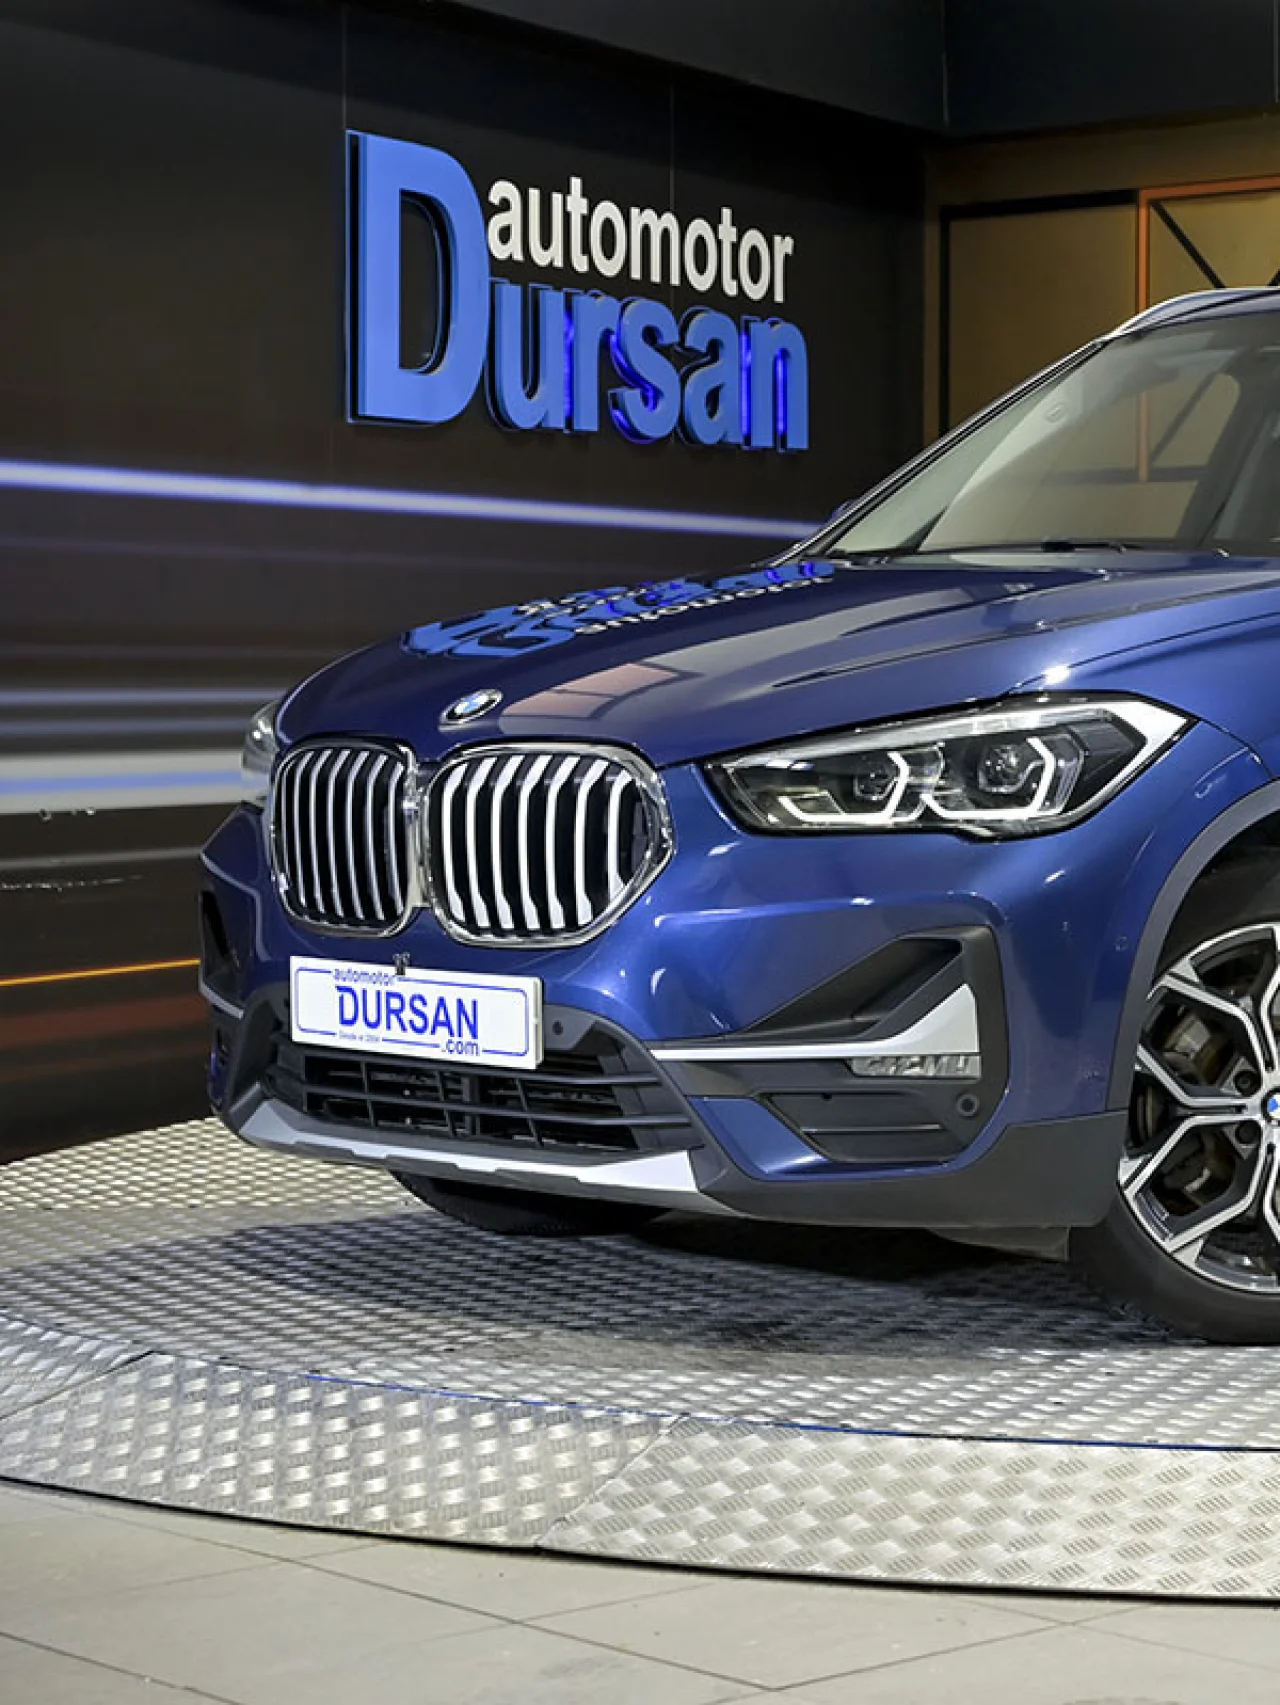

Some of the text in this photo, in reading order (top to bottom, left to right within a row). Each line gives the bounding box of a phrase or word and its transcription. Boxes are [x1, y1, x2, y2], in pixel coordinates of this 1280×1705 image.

[488, 176, 794, 303] automotor
[346, 129, 809, 453] Dursan
[333, 968, 397, 986] automotor
[335, 986, 479, 1040] DURSAN
[441, 1039, 480, 1056] .com
